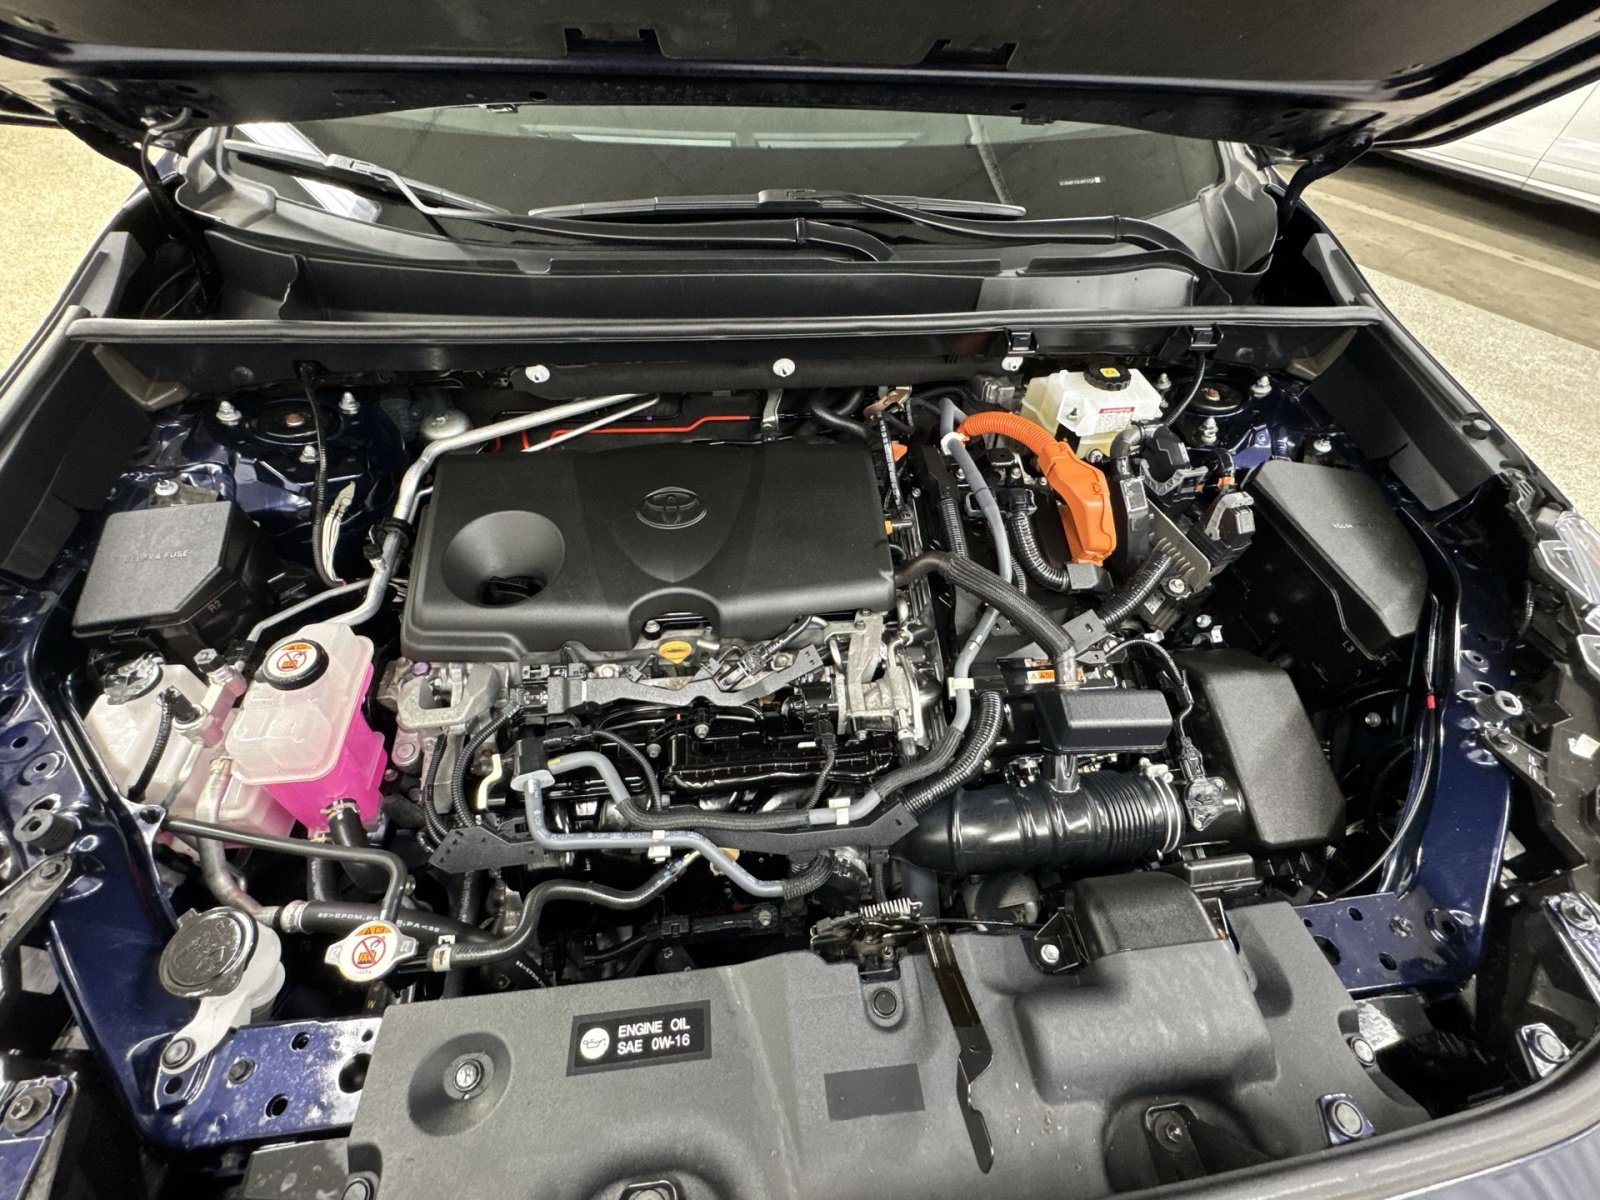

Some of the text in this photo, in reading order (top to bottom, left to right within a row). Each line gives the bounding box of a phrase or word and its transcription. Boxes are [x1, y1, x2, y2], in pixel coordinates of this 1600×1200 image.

[618, 1017, 690, 1038] ENGINE OIL
[617, 1033, 690, 1055] SAE 0W-16
